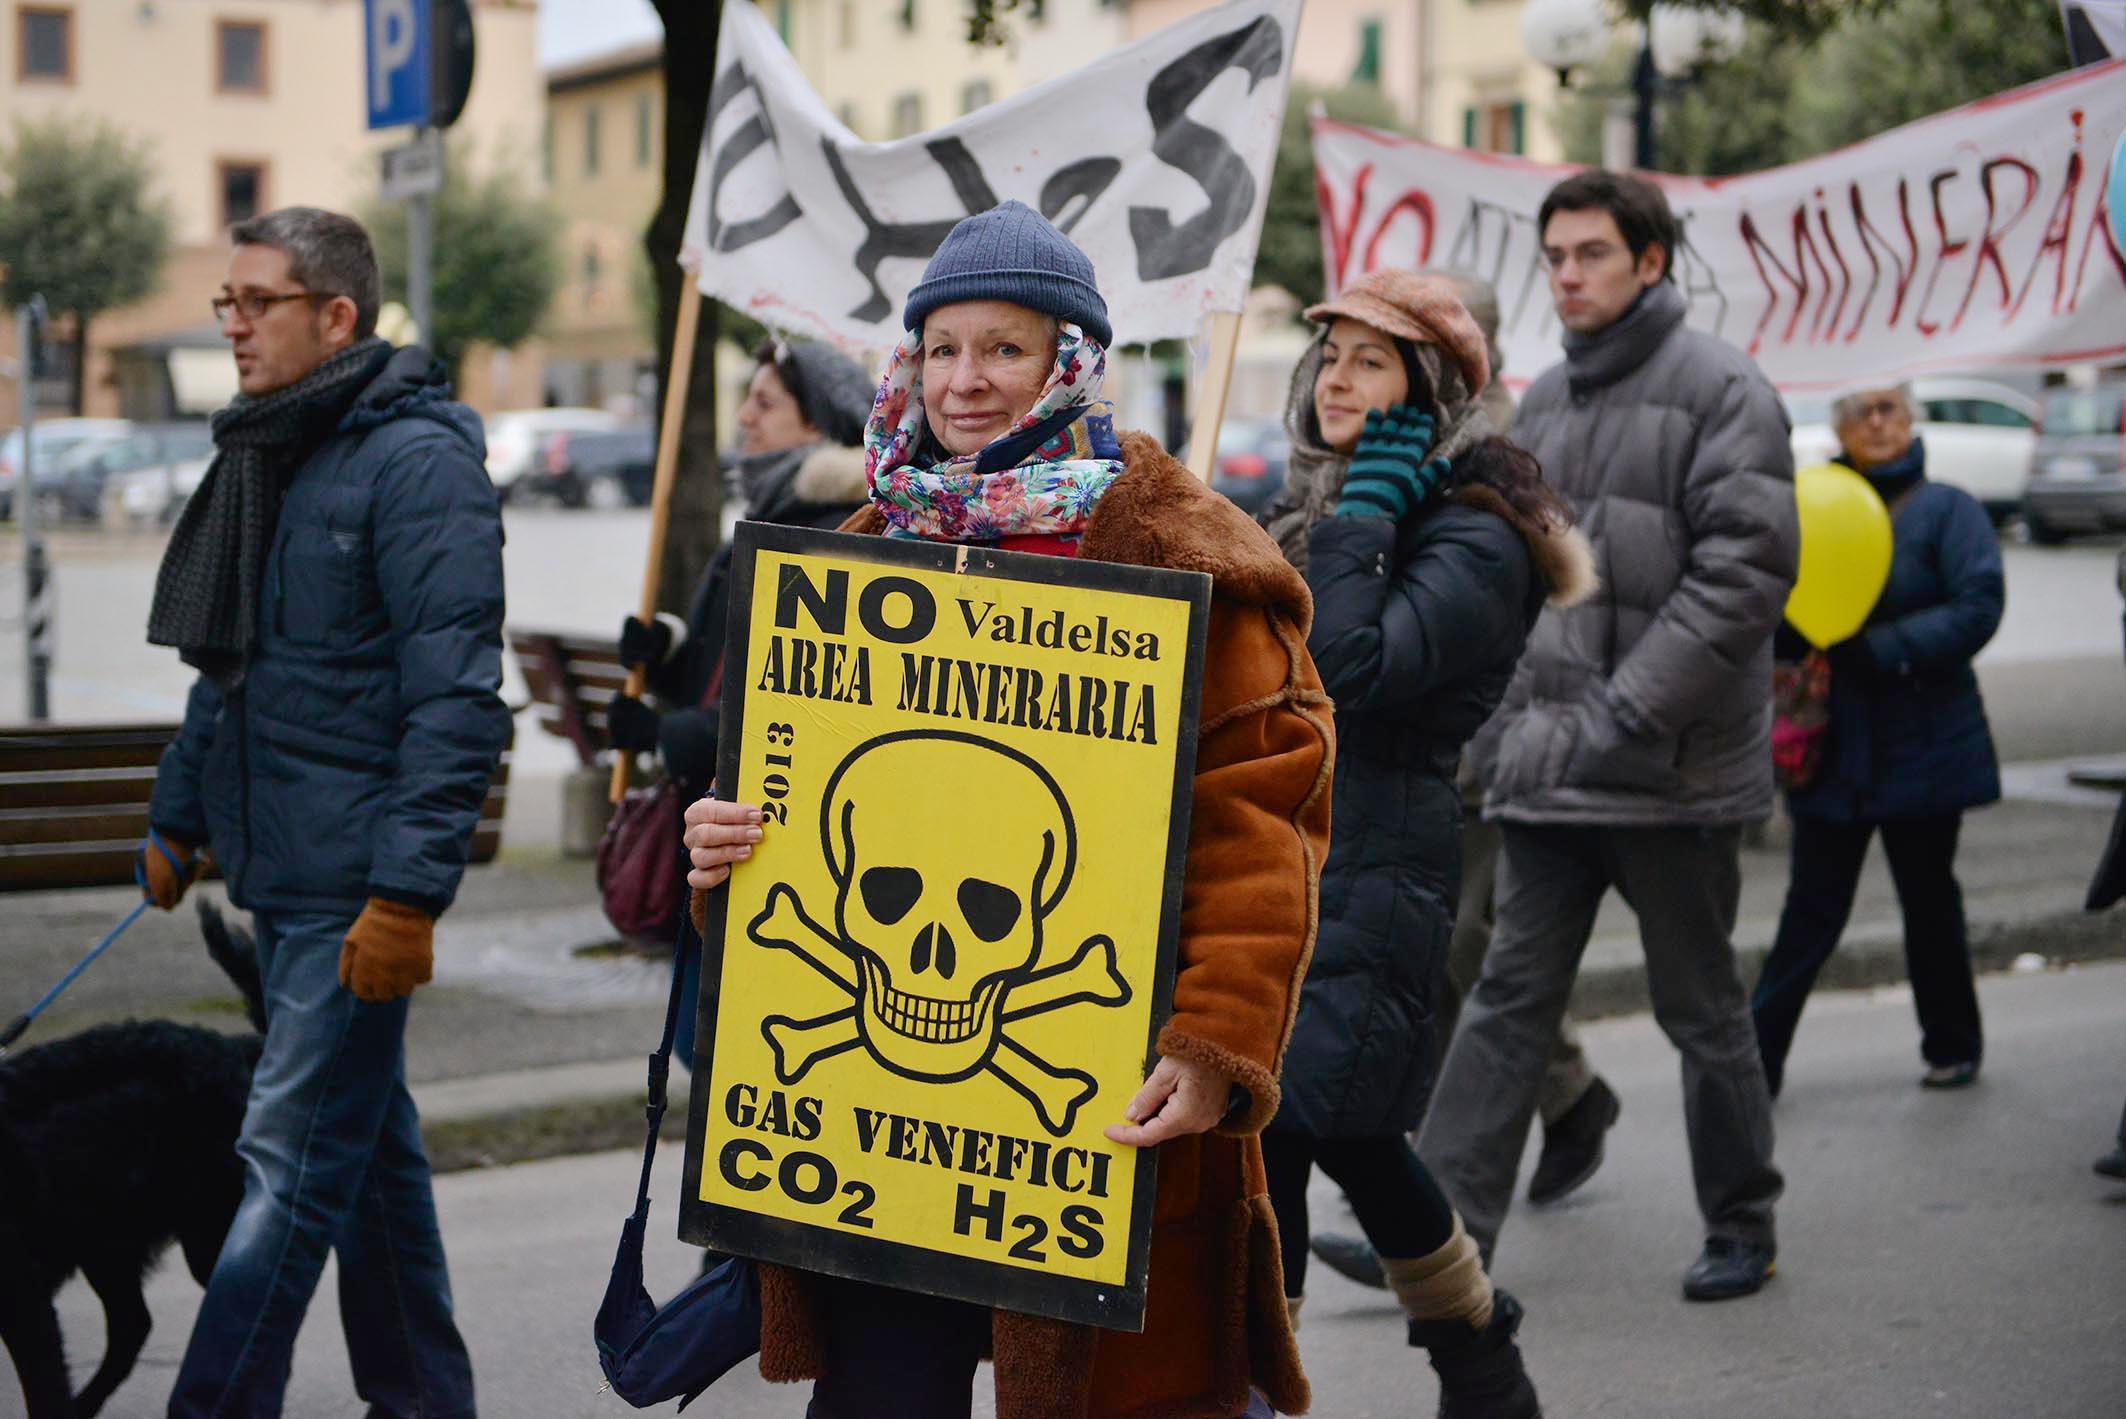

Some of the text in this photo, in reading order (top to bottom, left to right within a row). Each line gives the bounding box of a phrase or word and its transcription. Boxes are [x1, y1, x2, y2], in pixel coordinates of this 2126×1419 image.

[774, 562, 1161, 662] NO Valdelsa
[757, 635, 1158, 746] AREA MINERARIA
[762, 721, 794, 827] 2013
[724, 1083, 1113, 1199] GAS VENEFICI
[718, 1138, 1105, 1264] CO2 H2S
